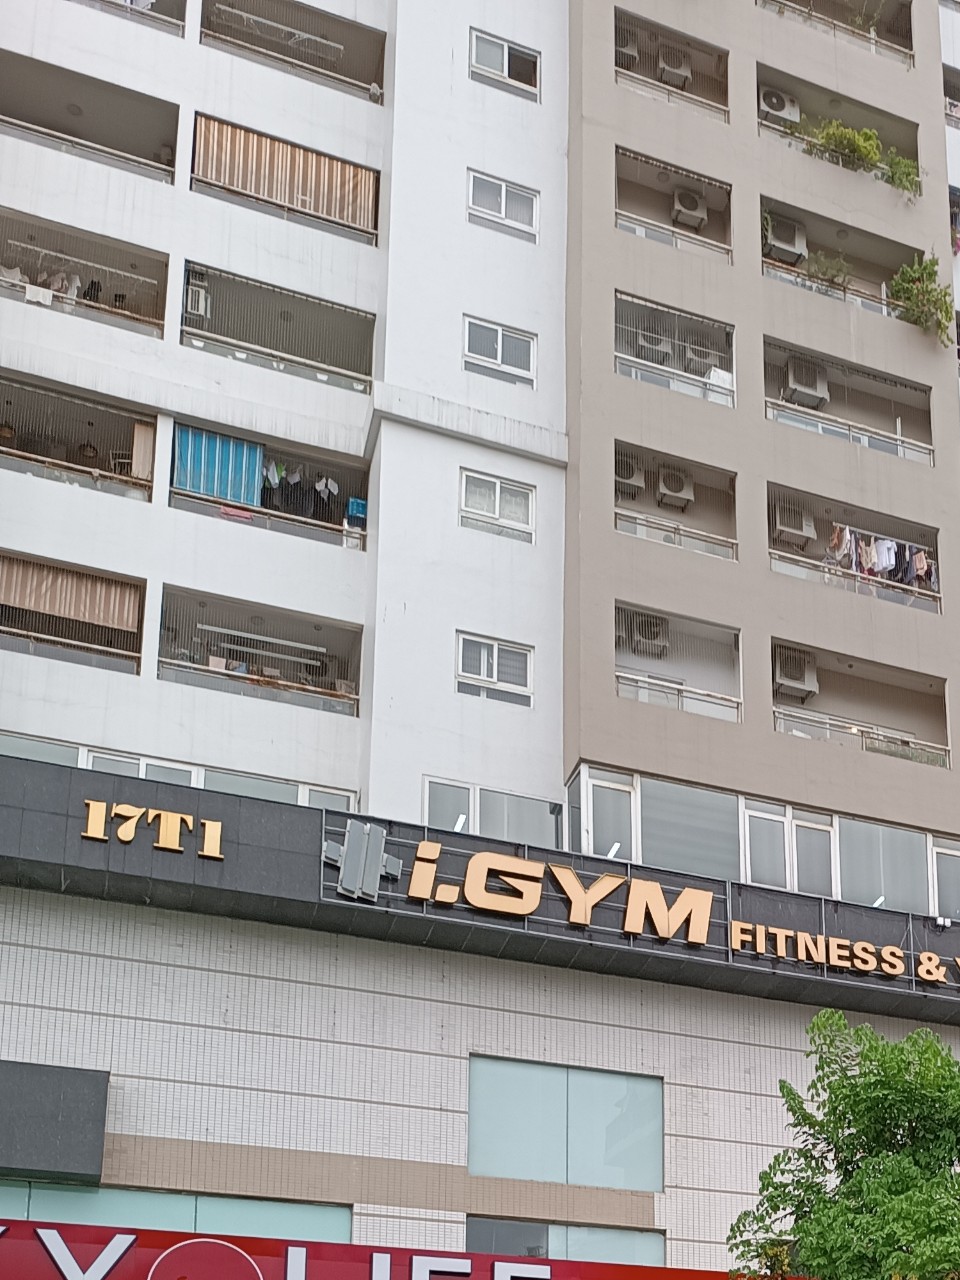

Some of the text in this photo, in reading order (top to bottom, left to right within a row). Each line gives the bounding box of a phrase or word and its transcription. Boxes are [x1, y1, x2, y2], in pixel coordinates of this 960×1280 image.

[81, 798, 225, 860] 17T1
[730, 919, 905, 977] FITNESS
[917, 948, 948, 983] &
